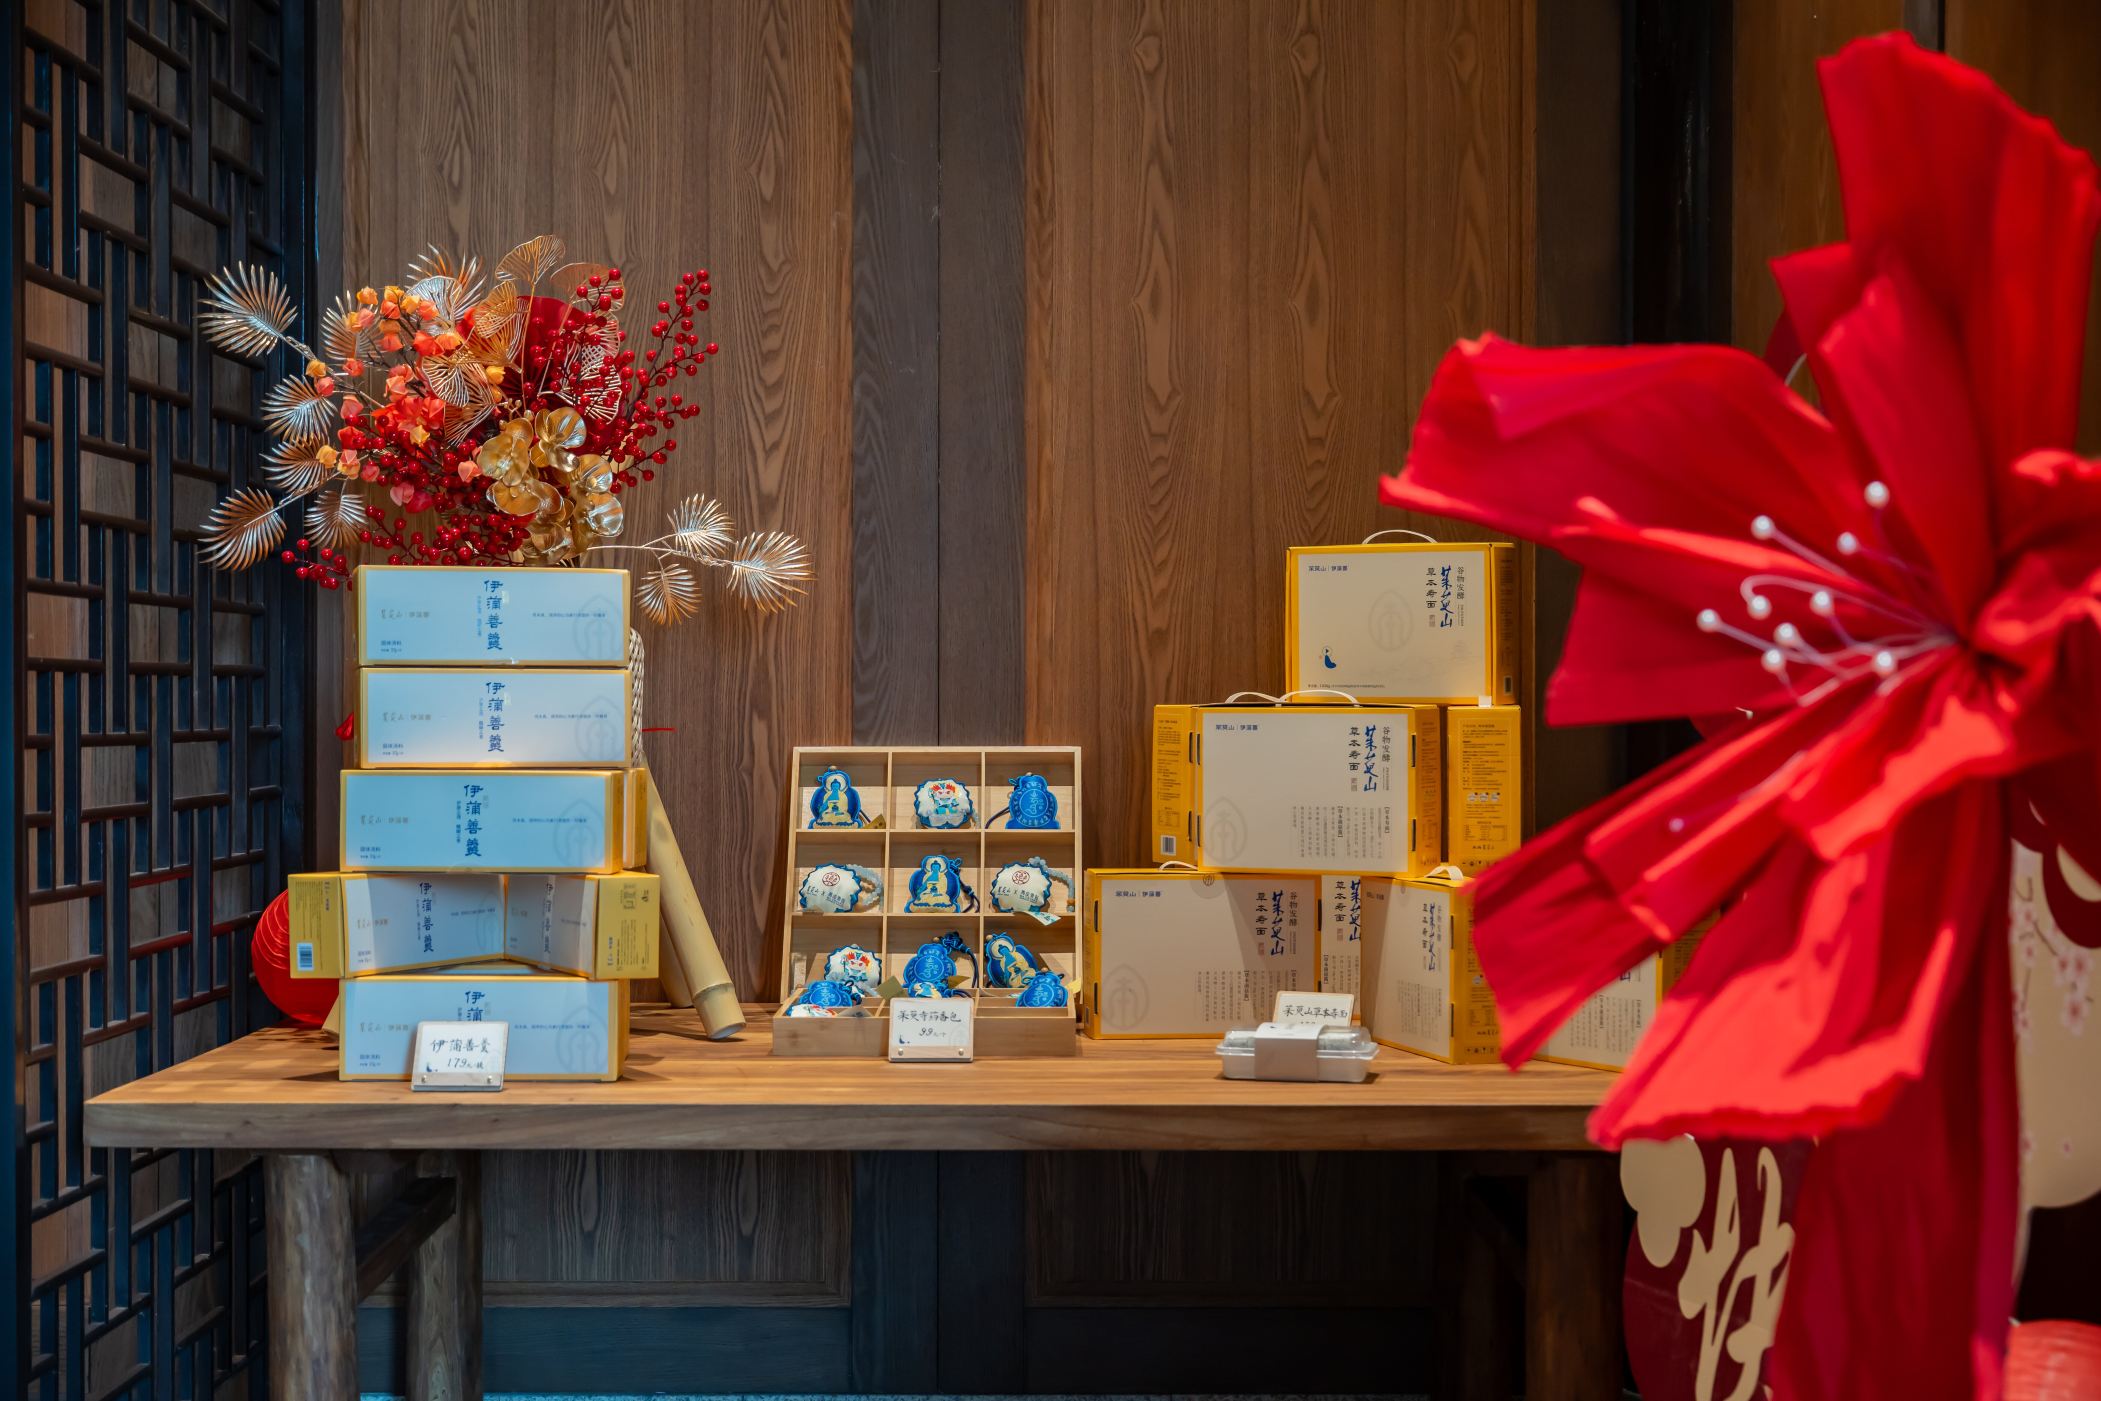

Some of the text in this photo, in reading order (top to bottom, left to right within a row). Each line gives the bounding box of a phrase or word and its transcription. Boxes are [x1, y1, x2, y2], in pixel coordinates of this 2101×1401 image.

[1426, 567, 1437, 608] 草本寿面
[1349, 726, 1361, 771] 草本寿面
[1256, 892, 1268, 935] 草本寿面
[1334, 881, 1346, 921] 草本寿面
